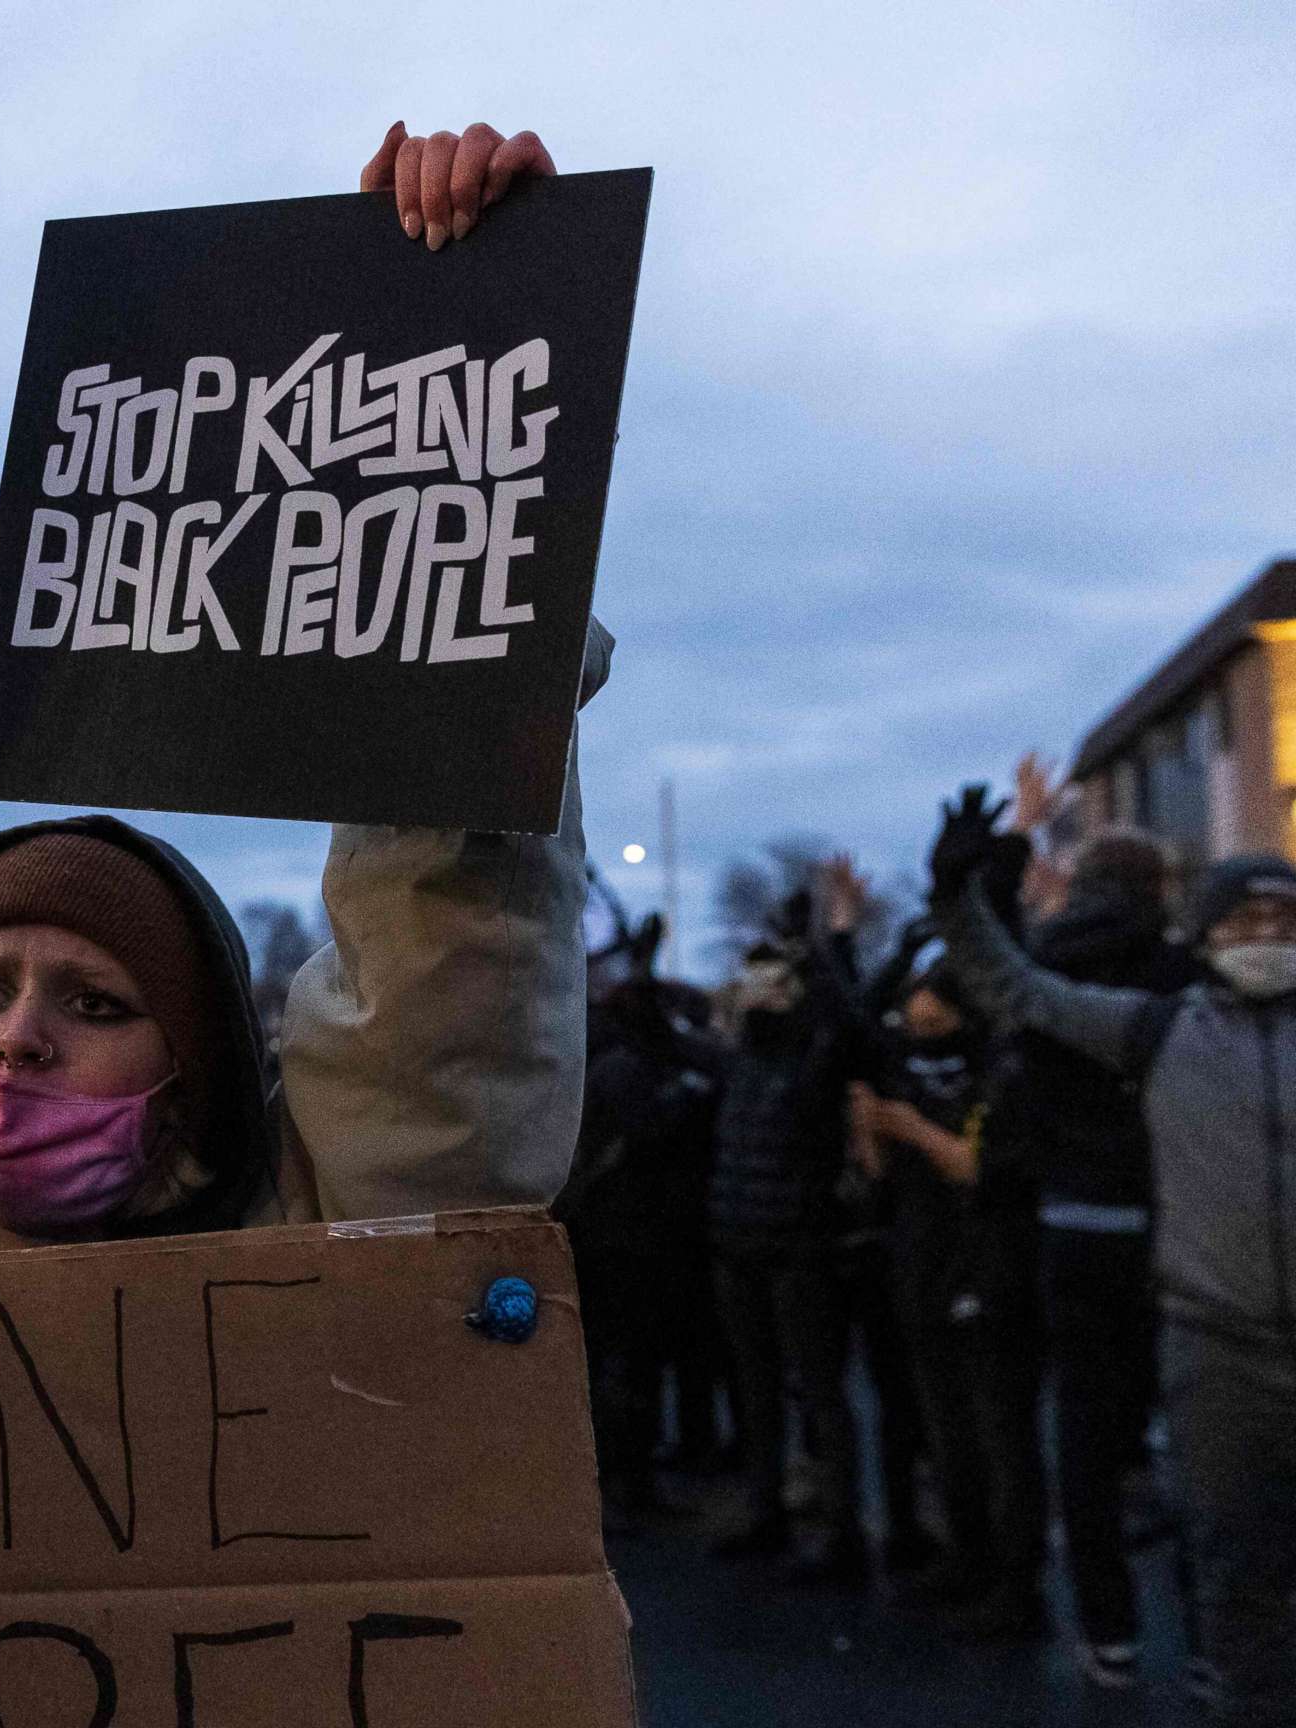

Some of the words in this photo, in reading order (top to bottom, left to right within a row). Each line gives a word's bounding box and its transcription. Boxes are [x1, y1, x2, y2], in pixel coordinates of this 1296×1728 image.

[41, 355, 237, 497] STOP
[234, 331, 561, 494] KILLING
[10, 492, 271, 654] BLACK
[260, 476, 545, 665] PEOPLE
